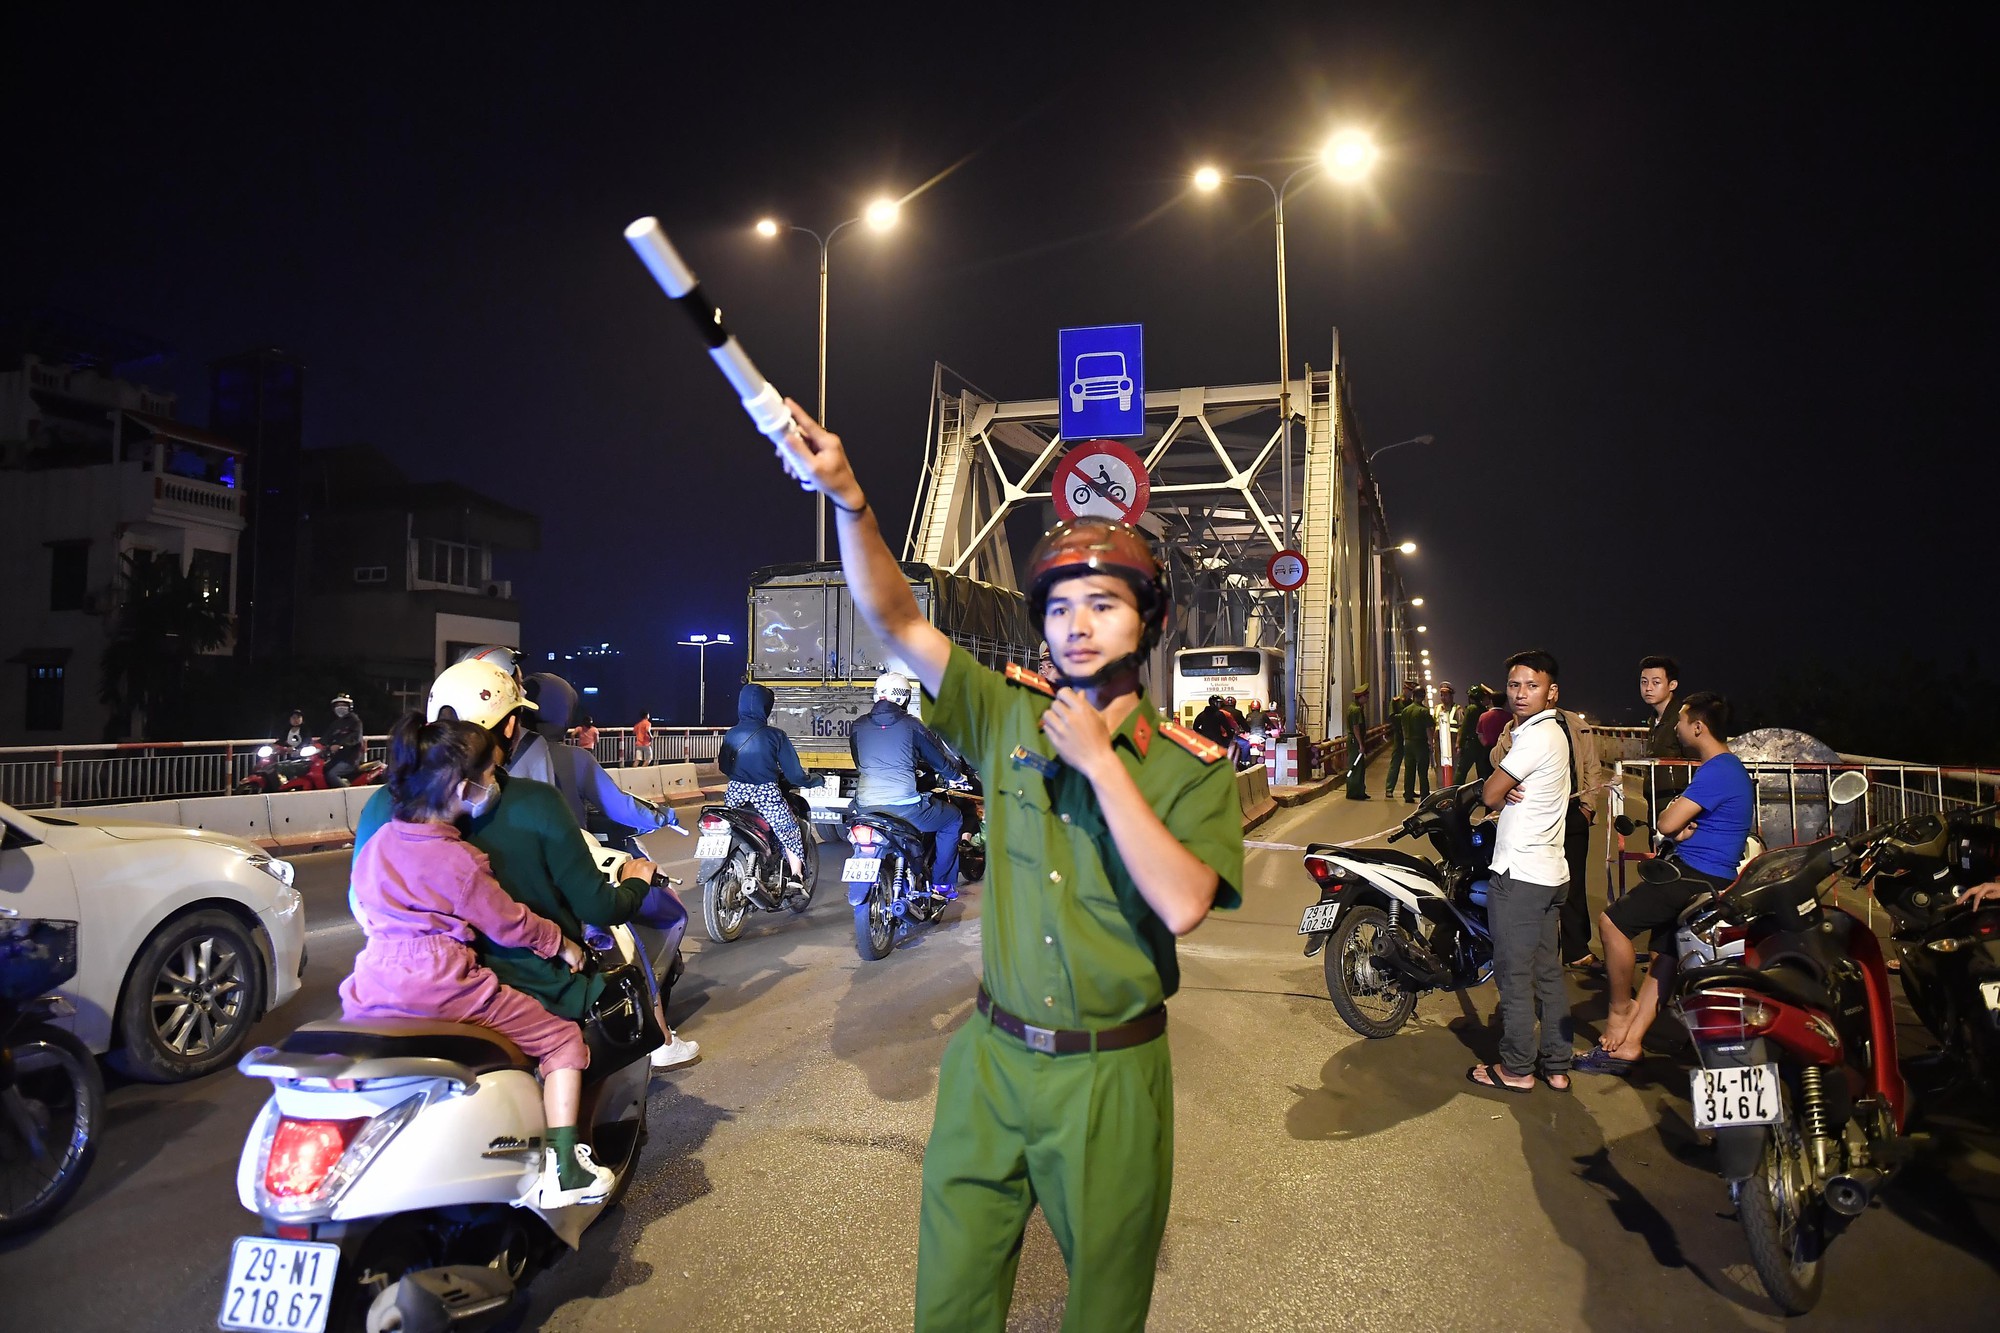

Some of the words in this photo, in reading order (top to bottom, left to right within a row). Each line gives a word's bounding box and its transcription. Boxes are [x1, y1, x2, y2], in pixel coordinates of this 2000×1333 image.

[1215, 657, 1224, 665] 17
[810, 719, 855, 737] 15C-30
[1307, 905, 1335, 919] 29-K1
[1301, 917, 1333, 931] 402.96
[1705, 1096, 1767, 1121] 3464
[244, 1246, 321, 1287] 29-N1
[227, 1286, 322, 1329] 218.67
